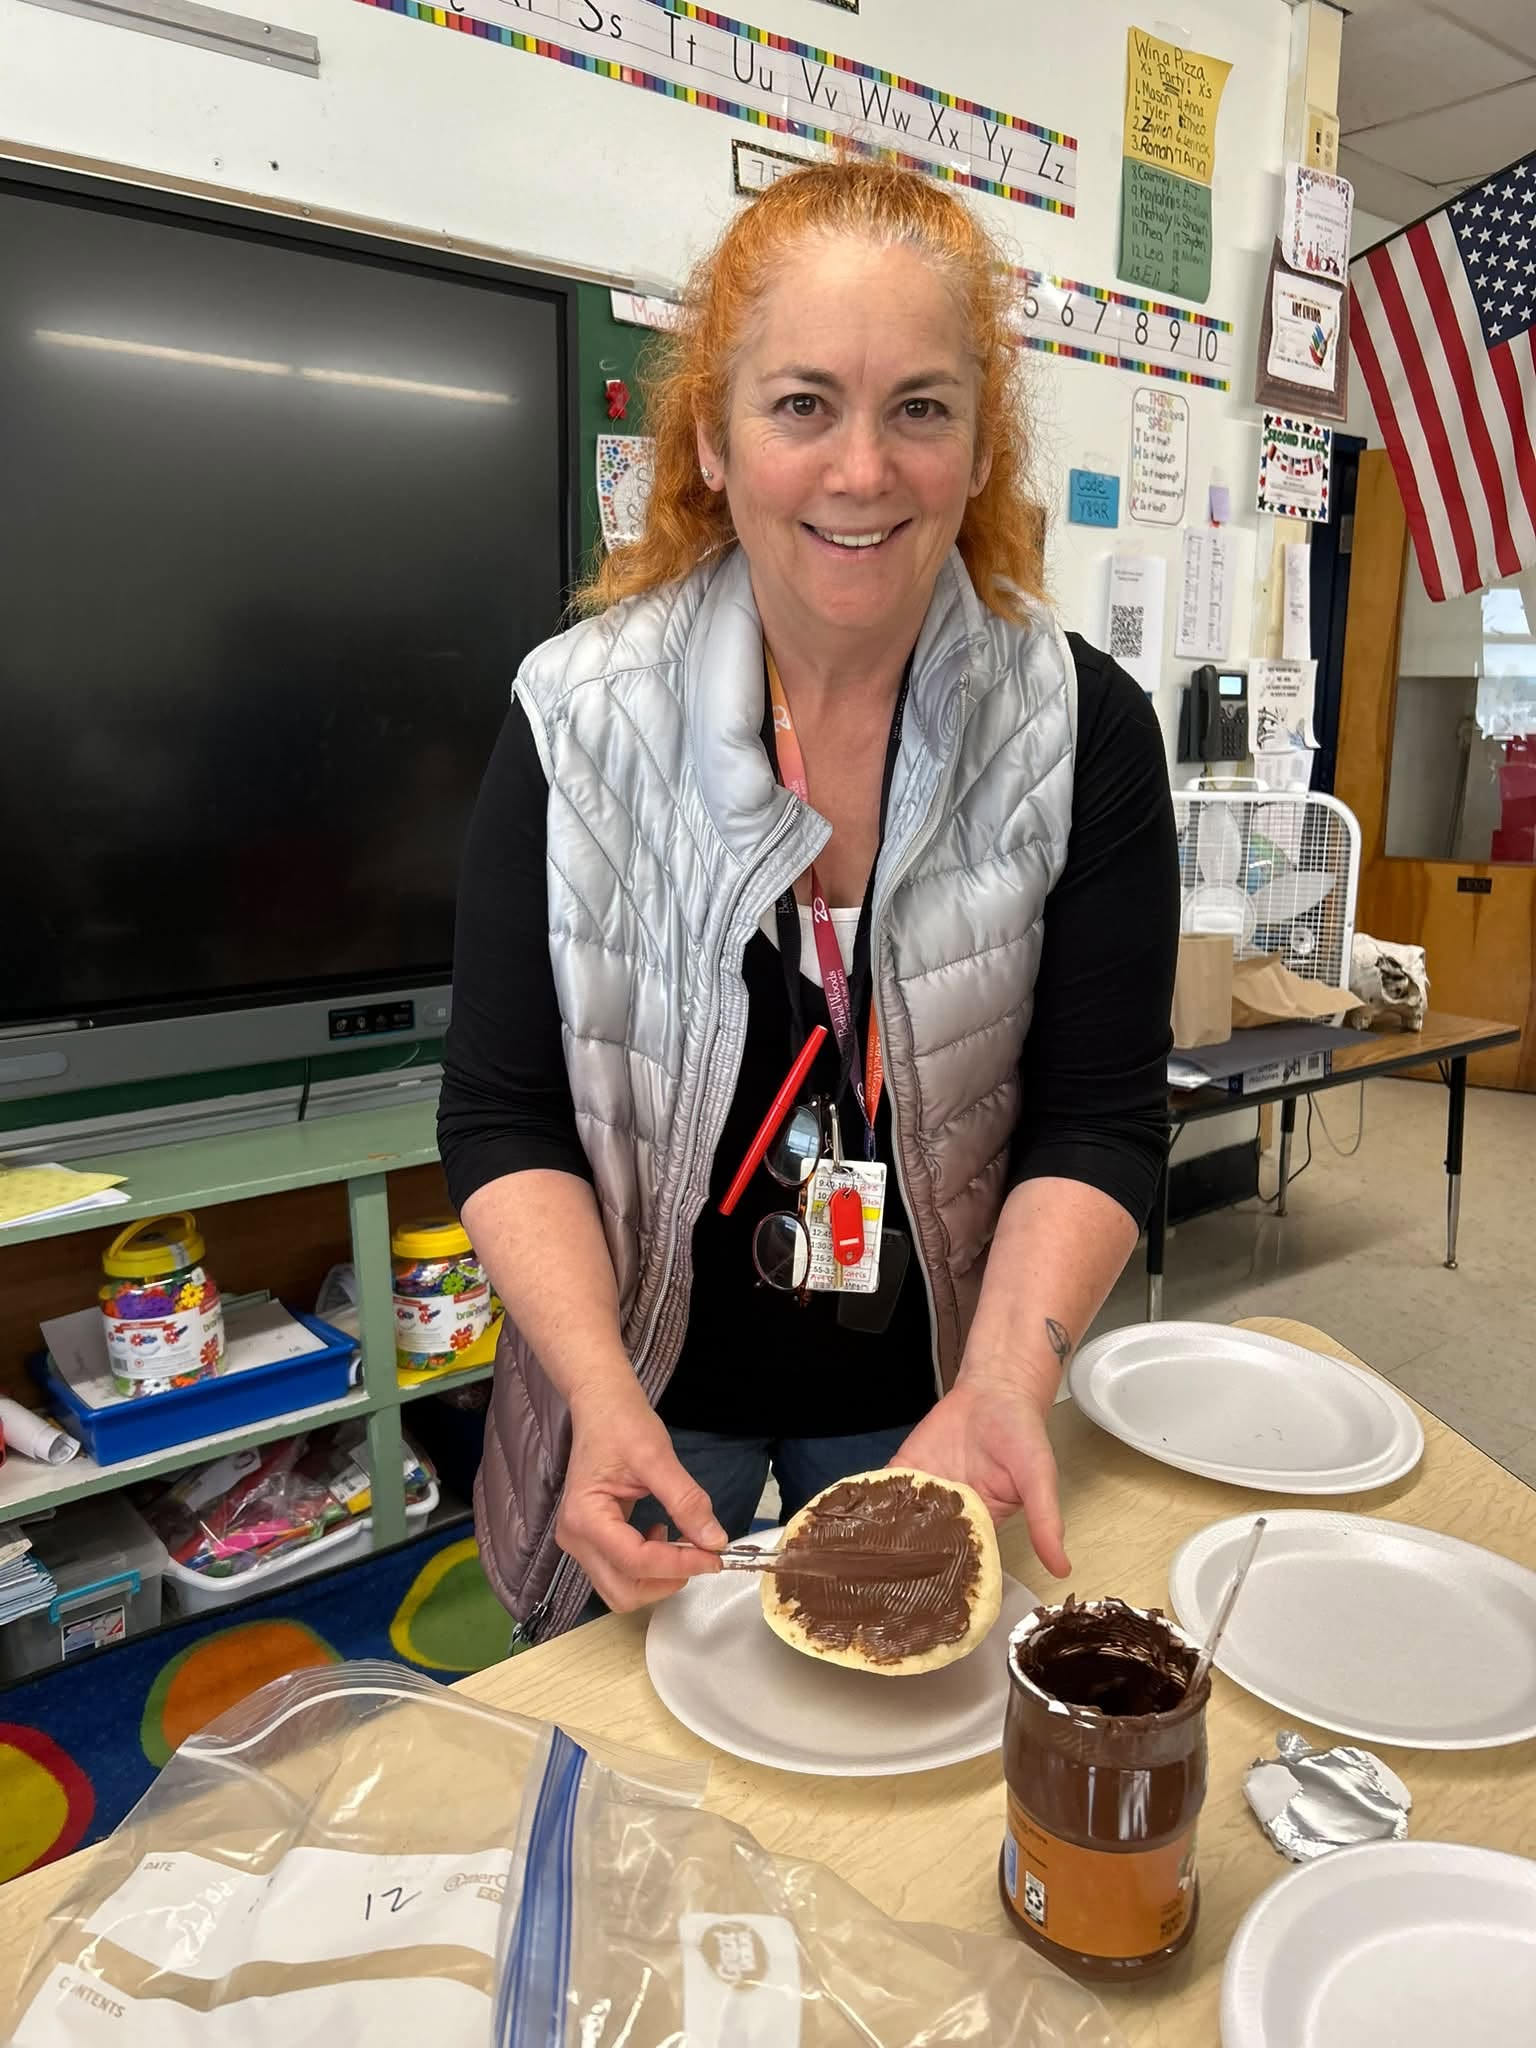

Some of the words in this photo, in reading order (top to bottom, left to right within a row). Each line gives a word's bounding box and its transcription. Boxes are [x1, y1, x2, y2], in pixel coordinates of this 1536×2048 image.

[1174, 46, 1206, 80] Pizza
[664, 10, 696, 65] Tt
[733, 36, 773, 93] Uu
[801, 58, 838, 110] Vv
[858, 78, 911, 133] Ww
[928, 102, 959, 150] Xx
[983, 120, 1013, 182] Yy
[1038, 139, 1064, 184] Zz
[1142, 99, 1170, 121] Tyler
[1061, 293, 1075, 327] 6
[1095, 300, 1109, 334] 7
[1134, 311, 1149, 345] 8
[1169, 320, 1181, 352] 9
[1197, 327, 1218, 362] 10
[825, 969, 842, 1006] Woods
[143, 1861, 177, 1872] DATE
[365, 1886, 424, 1921] 12
